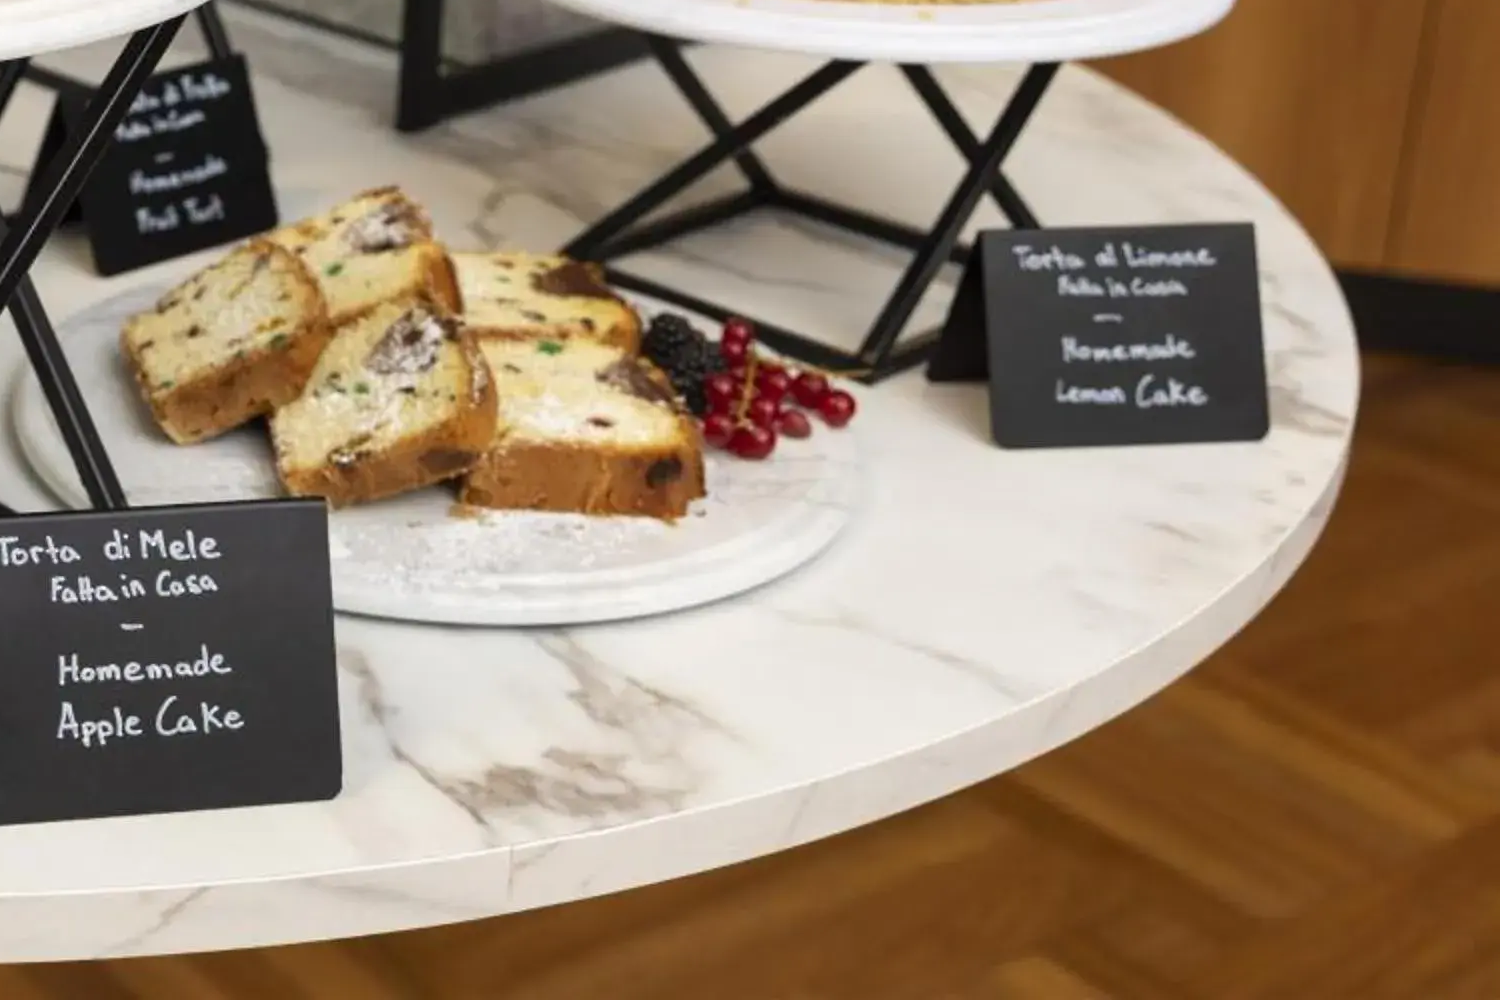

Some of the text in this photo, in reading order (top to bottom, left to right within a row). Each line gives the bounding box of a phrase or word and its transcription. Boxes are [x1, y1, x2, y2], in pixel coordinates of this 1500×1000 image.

[1012, 245, 1086, 271] Torta
[1121, 242, 1217, 269] Limone
[1061, 333, 1197, 363] Homemade
[1055, 374, 1209, 408] Lemon Cake
[103, 528, 131, 561] di
[139, 529, 222, 561] Mele
[51, 569, 219, 604] Fatta in Casa
[58, 643, 233, 686] Homemade
[56, 695, 245, 748] Apple Cake
